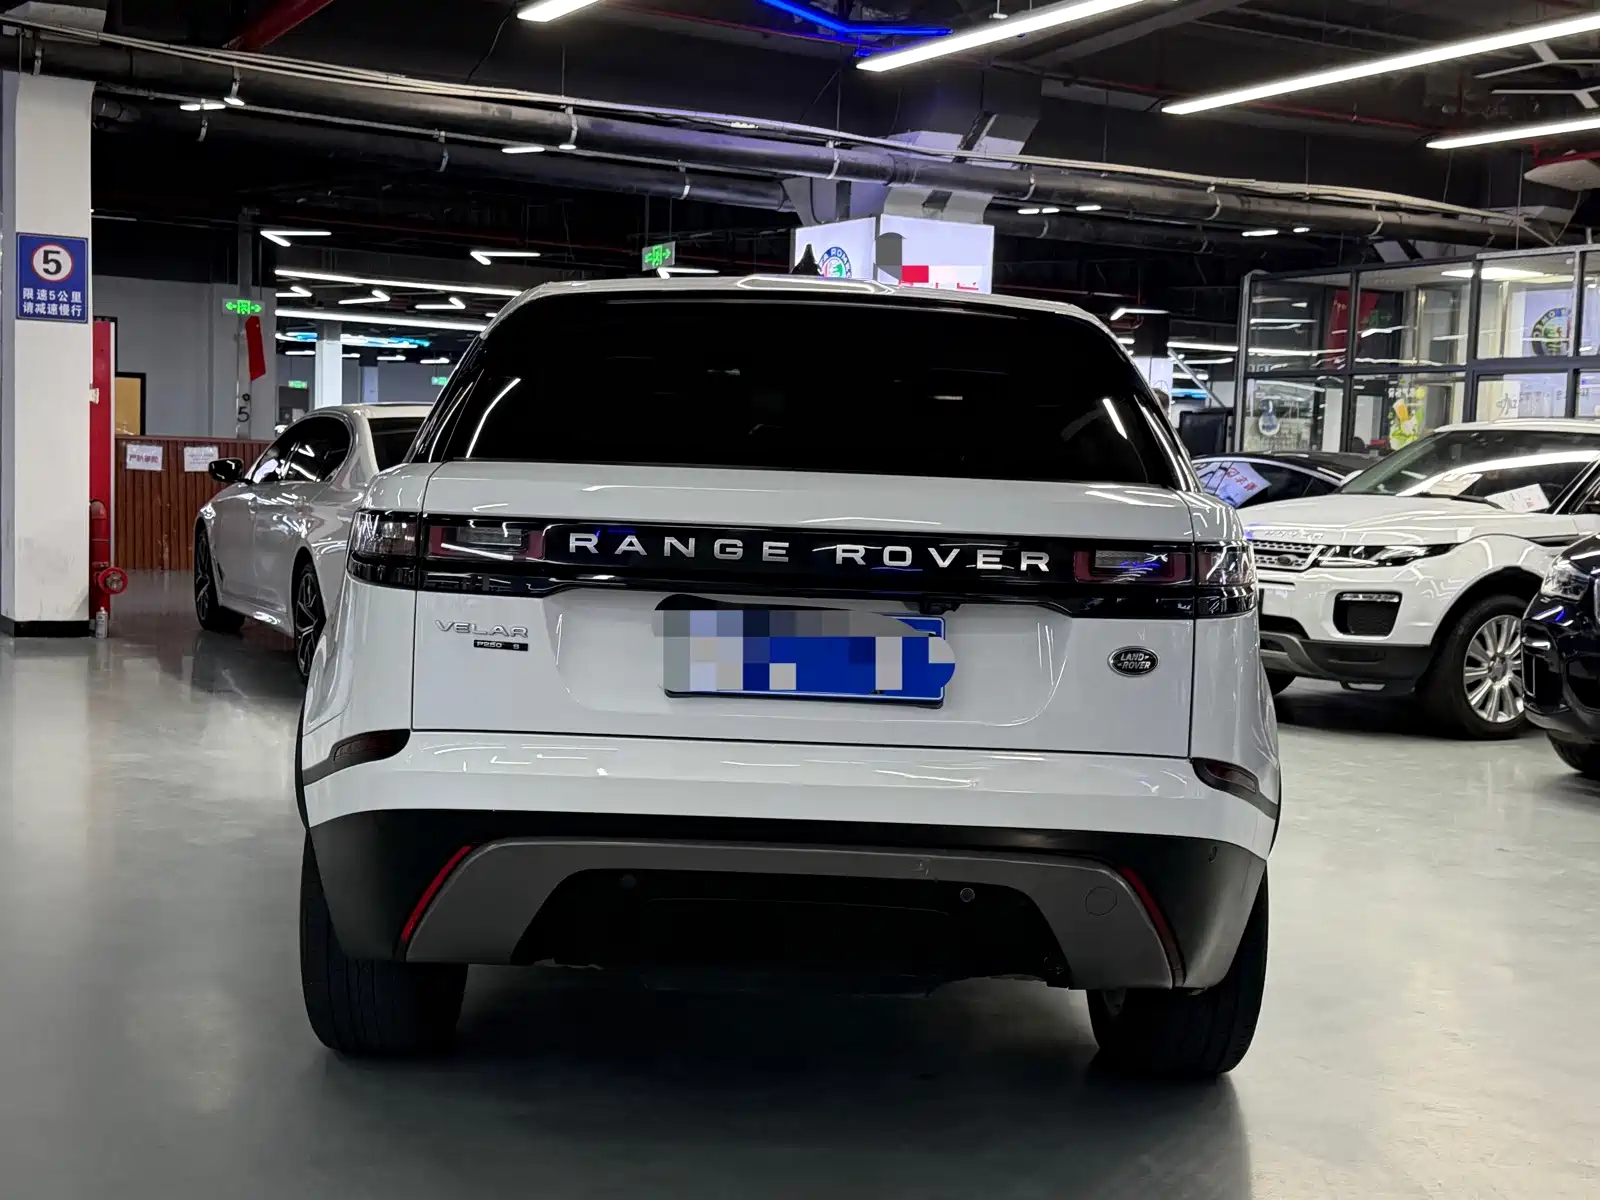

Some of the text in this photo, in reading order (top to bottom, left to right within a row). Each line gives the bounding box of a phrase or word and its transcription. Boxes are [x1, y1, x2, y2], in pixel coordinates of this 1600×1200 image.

[43, 250, 62, 275] 5
[23, 288, 82, 303] 限速5公里
[23, 302, 82, 317] 请减速慢行
[568, 532, 1051, 572] RANGE ROVER
[435, 620, 528, 638] VELAR
[1121, 653, 1144, 661] LAND
[1122, 661, 1151, 669] ROVER
